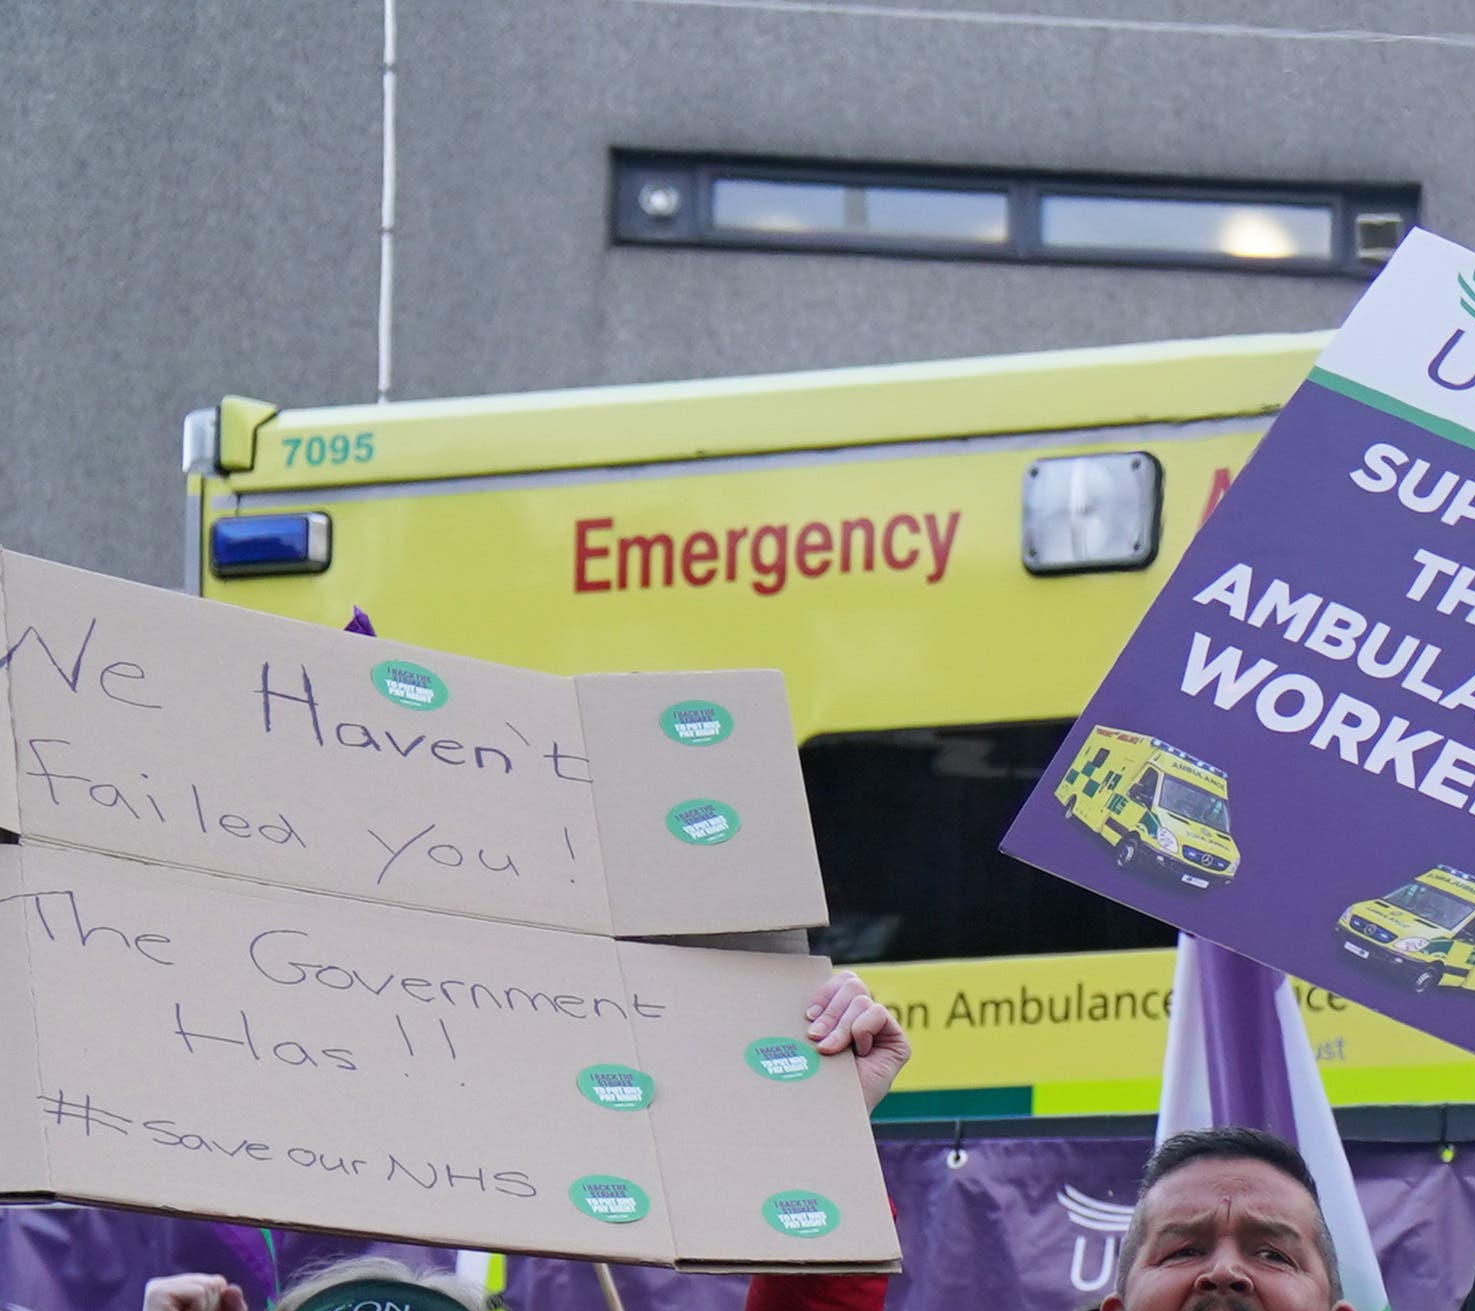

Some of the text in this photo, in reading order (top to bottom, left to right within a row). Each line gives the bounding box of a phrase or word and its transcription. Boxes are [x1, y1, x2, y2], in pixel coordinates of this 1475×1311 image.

[281, 433, 374, 467] 7095
[574, 511, 961, 597] Emergency
[254, 662, 594, 783] Haven't
[27, 739, 306, 847] Failed
[0, 890, 666, 1019] The Government
